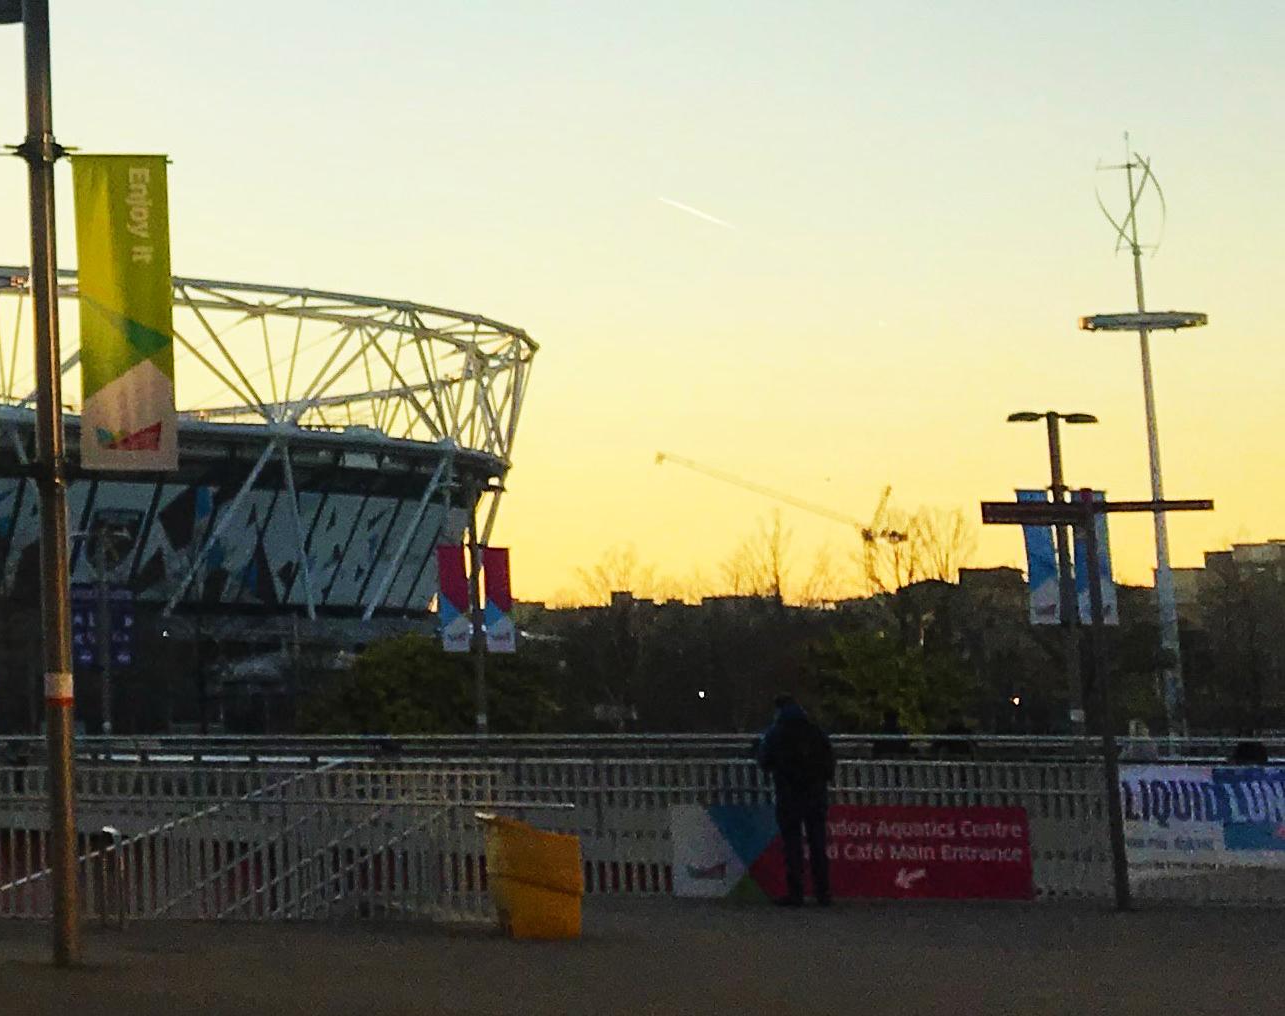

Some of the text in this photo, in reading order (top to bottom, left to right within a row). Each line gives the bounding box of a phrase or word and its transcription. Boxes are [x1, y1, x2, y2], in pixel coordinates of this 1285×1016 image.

[125, 168, 152, 238] Enjoy
[1122, 779, 1221, 828] LIQUID
[877, 820, 955, 840] Aquatics
[961, 819, 1023, 838] Centre
[890, 844, 936, 861] Main
[941, 843, 1023, 862] Entrance
